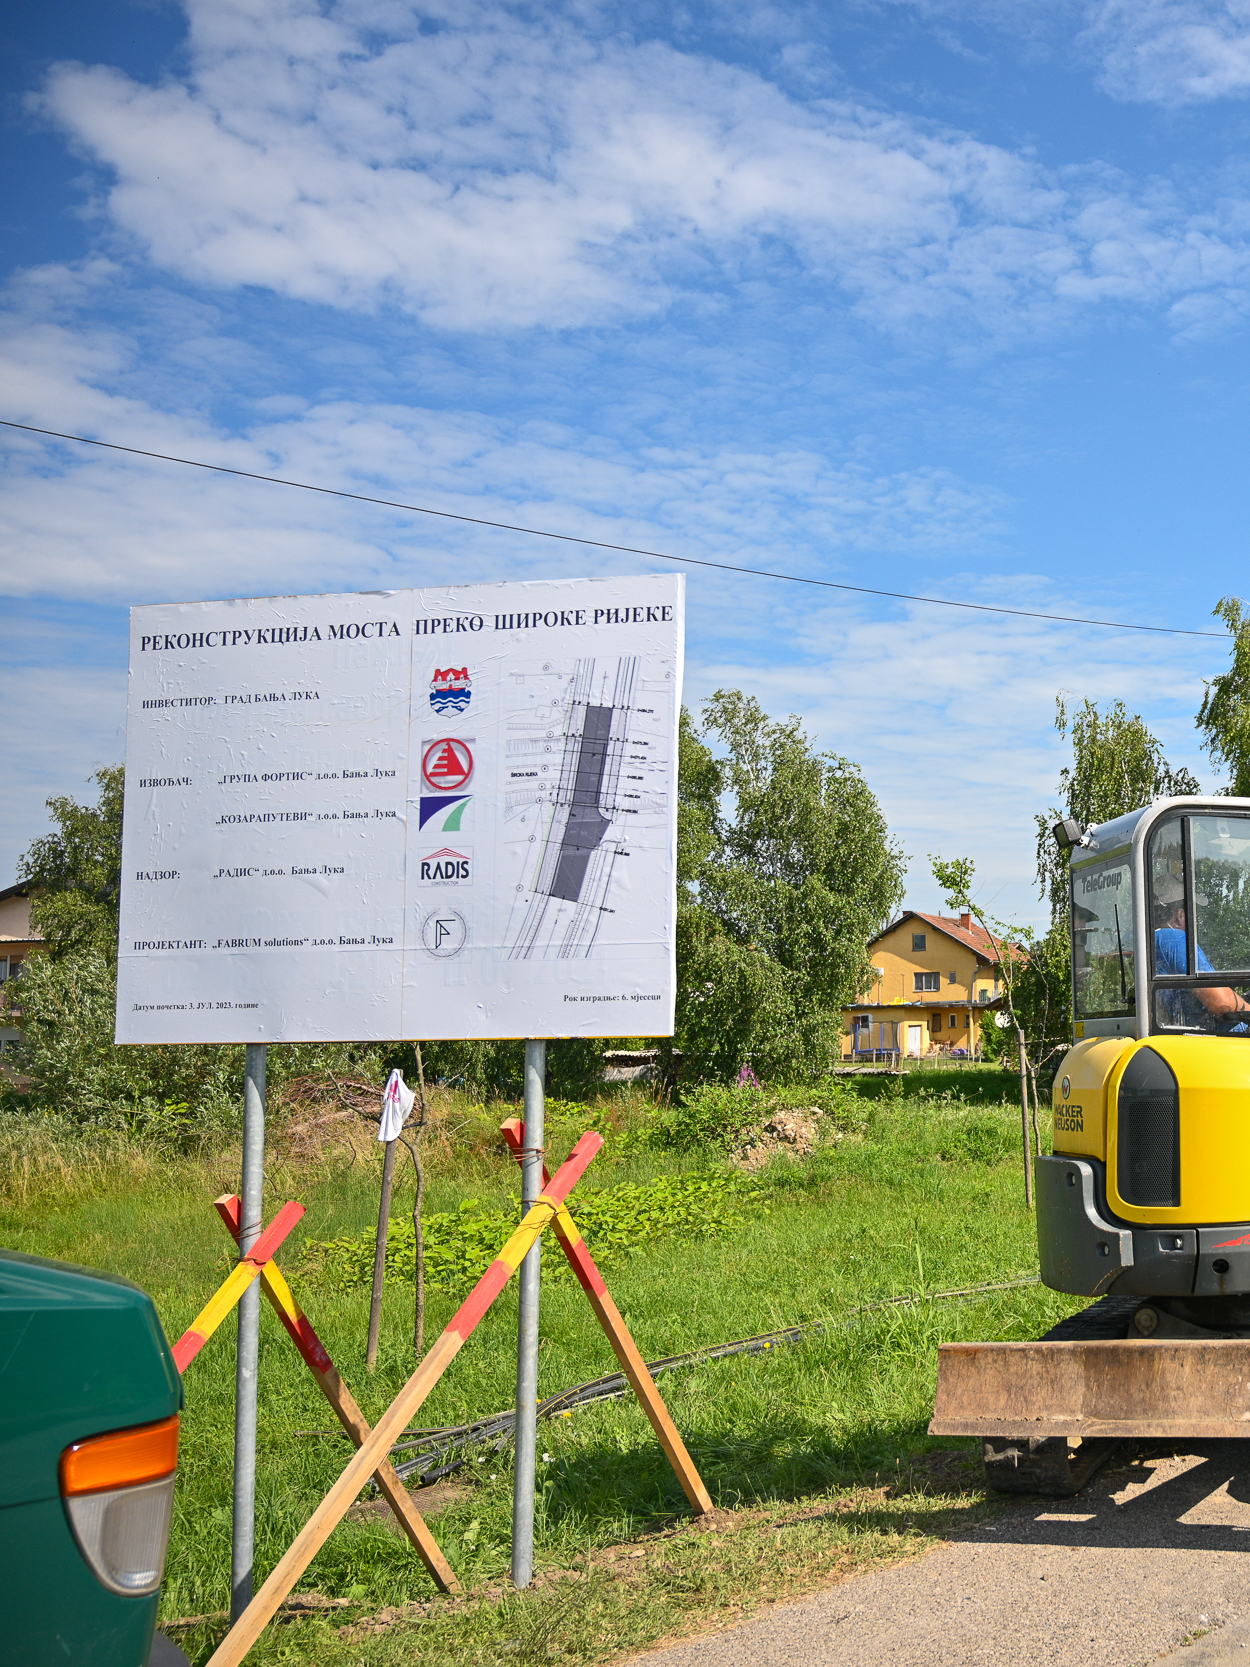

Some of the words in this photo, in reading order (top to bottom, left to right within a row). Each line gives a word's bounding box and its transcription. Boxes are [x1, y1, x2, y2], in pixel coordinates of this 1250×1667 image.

[141, 626, 322, 651] РЕКОНСТРУКЦИЈА
[328, 621, 401, 641] МОСТА
[415, 616, 484, 635] ПРЕКО
[494, 610, 587, 630] ШИРОКЕ
[593, 605, 673, 625] РИЈЕКЕ
[142, 696, 217, 709] ИНВЕСТИТОР:
[224, 694, 252, 705] ГРАД
[254, 692, 286, 703] БАЊА
[289, 690, 320, 701] ЛУКА
[139, 777, 193, 788] ИЗВОЂАЧ:
[342, 769, 368, 779] Бања
[371, 768, 396, 778] Лука
[342, 810, 369, 820] Бања
[371, 809, 397, 819] Лука
[136, 870, 181, 881] НАДЗОР:
[262, 867, 286, 877] д.о.о.
[291, 866, 317, 876] Бања
[319, 865, 345, 875] Лука
[421, 861, 469, 880] RADIS
[1081, 872, 1122, 894] TeleGroup
[133, 940, 207, 951] ПРОЈЕКТАНТ:
[338, 935, 365, 945] Бања
[367, 935, 394, 945] Лука
[563, 994, 579, 1002] Рок
[132, 1003, 155, 1012] Датум
[156, 1003, 187, 1011] почетка:
[234, 1002, 259, 1010] године
